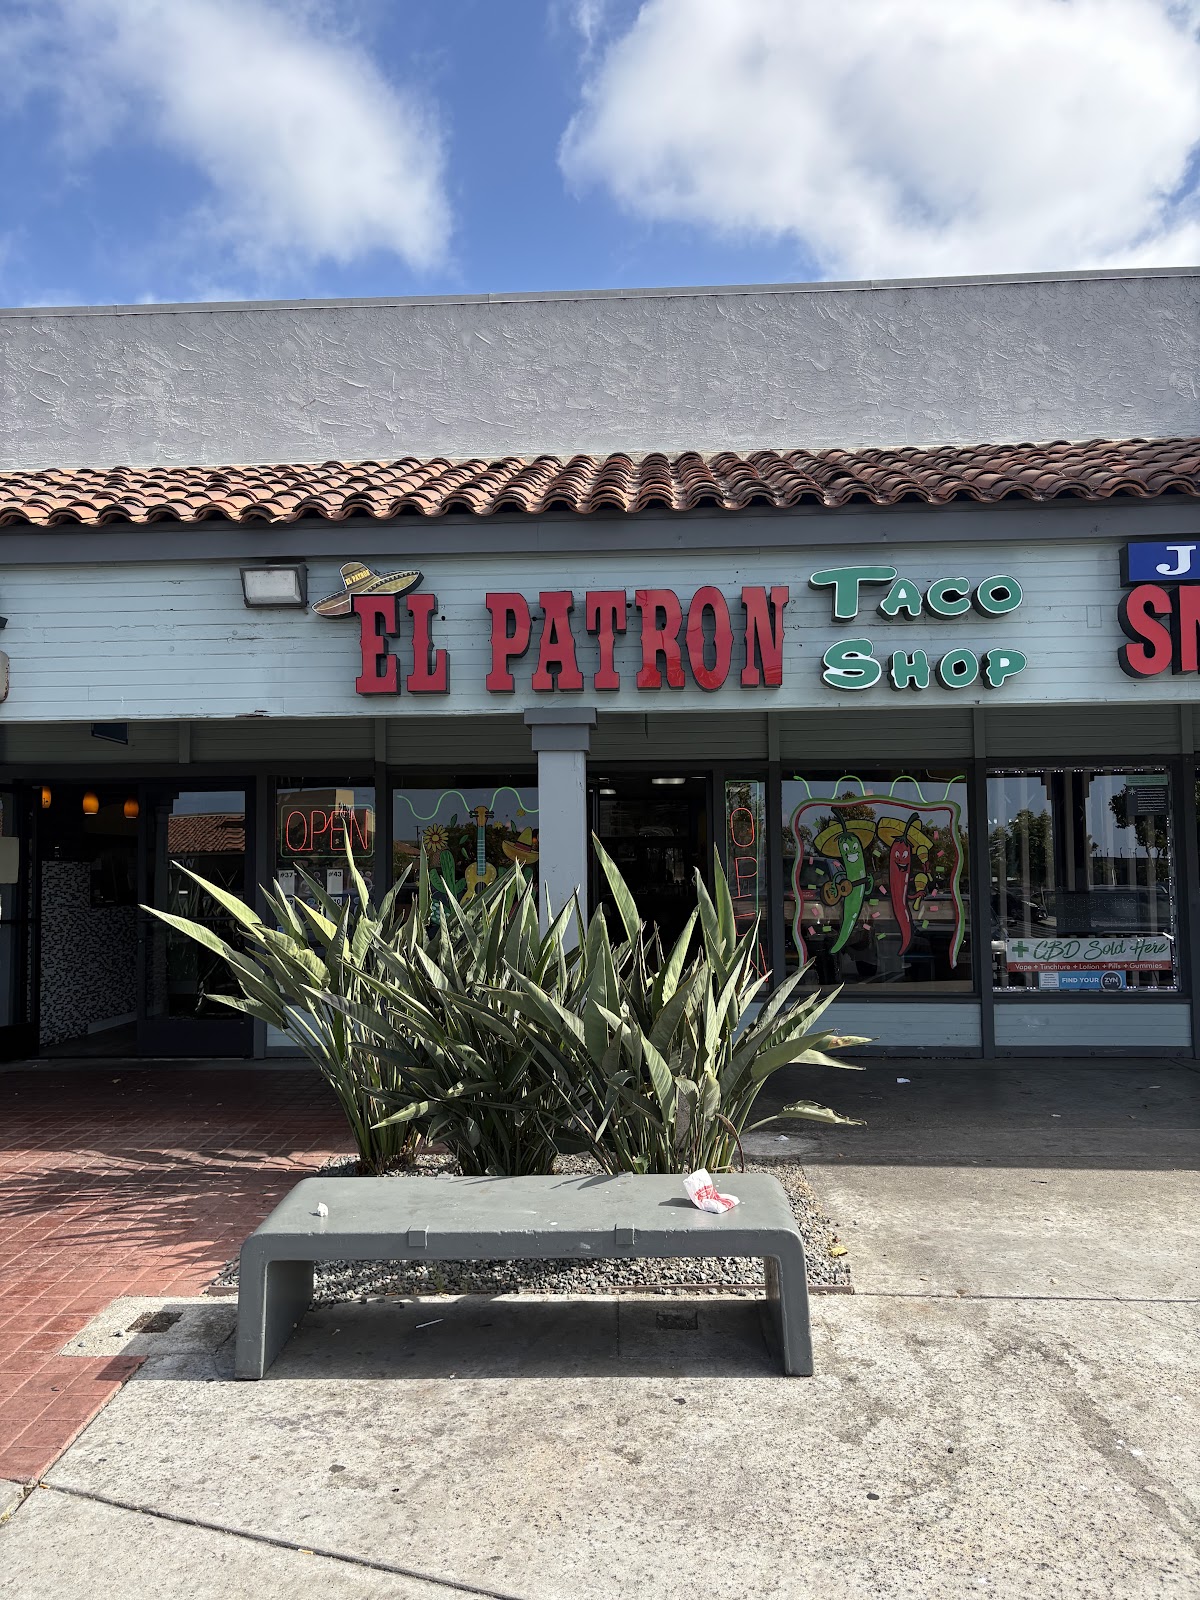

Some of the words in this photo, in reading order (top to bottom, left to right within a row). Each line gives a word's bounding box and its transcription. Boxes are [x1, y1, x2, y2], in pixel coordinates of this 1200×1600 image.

[1155, 545, 1197, 576] J
[809, 566, 1024, 622] TACO
[353, 594, 450, 694] EL
[486, 585, 790, 693] PATRON
[821, 638, 1028, 691] SHOP
[286, 810, 368, 851] OPEN
[1015, 963, 1032, 971] Vape
[1033, 940, 1081, 962] CBD
[1084, 940, 1126, 960] Sold
[1130, 938, 1169, 961] Here
